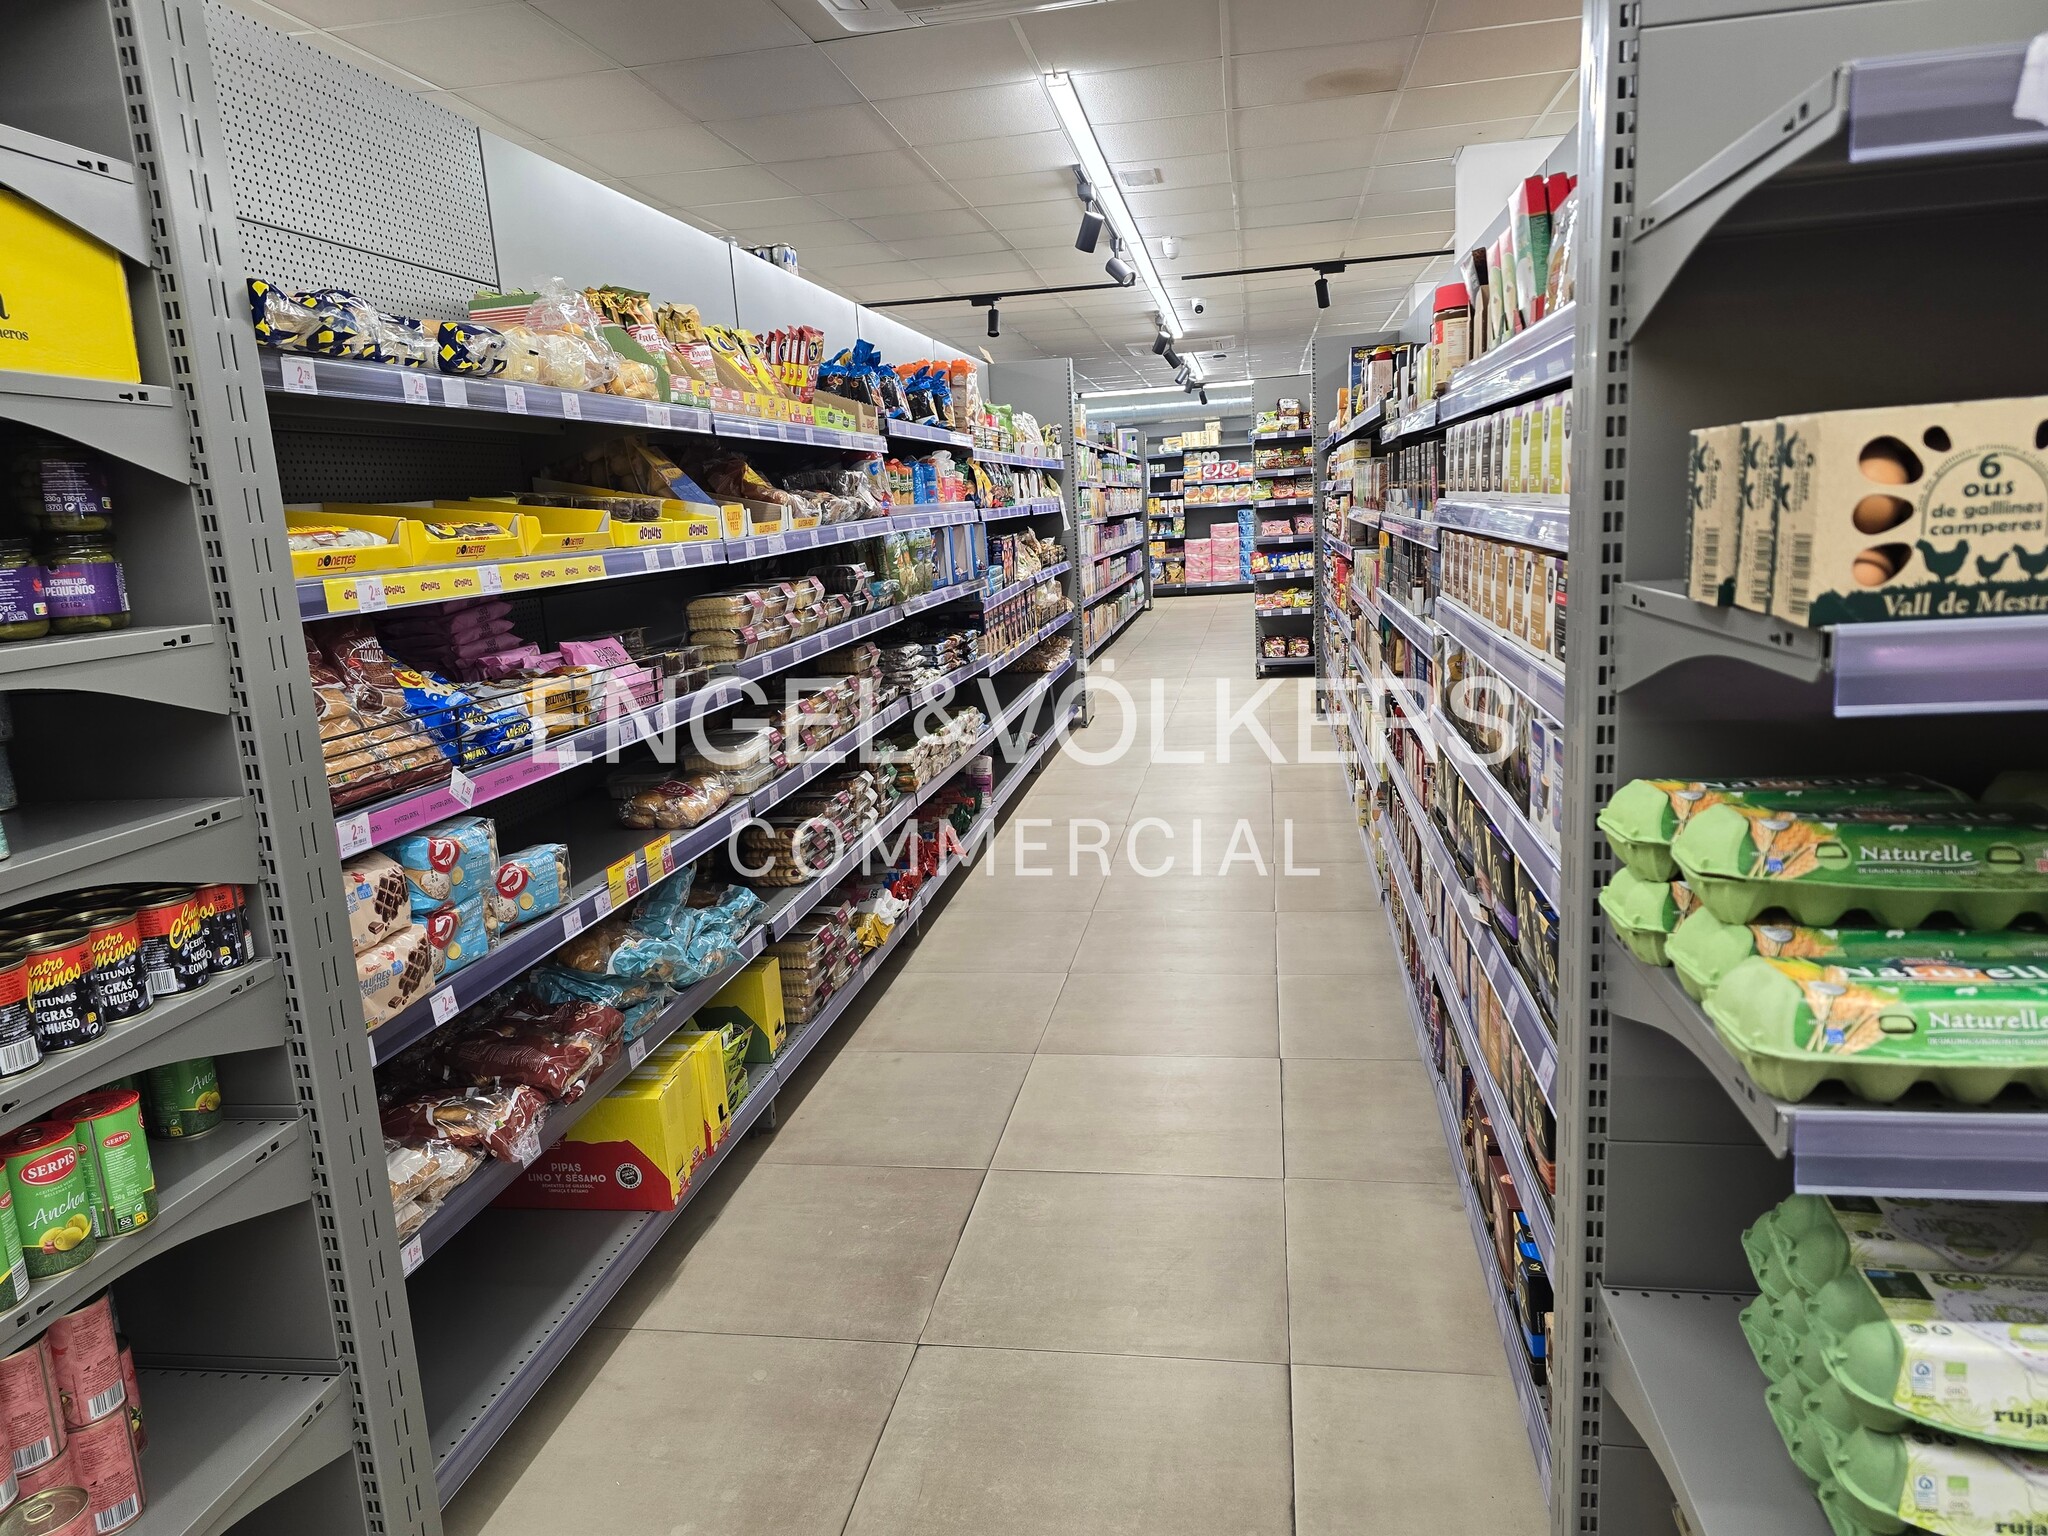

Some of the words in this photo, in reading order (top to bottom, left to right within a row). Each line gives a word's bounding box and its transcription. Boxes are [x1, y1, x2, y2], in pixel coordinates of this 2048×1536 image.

[1979, 452, 2001, 479] 6
[1964, 481, 2014, 497] ous
[1931, 504, 1956, 518] de
[640, 525, 662, 540] donuts
[689, 524, 708, 536] donuts
[1930, 520, 2042, 536] camperes
[456, 544, 486, 555] DONETTES
[317, 555, 356, 567] DONETTES
[421, 581, 440, 591] donuts
[454, 578, 473, 588] donuts
[1883, 591, 1932, 617] Vall
[1937, 591, 1970, 614] de
[1860, 844, 1974, 862] Naturelle
[95, 936, 137, 968] minos
[97, 964, 135, 981] EITUNAS
[99, 978, 134, 996] EGRAS
[33, 992, 77, 1008] EITUNAS
[110, 989, 139, 1006] HUESO
[36, 1006, 74, 1023] EGRAS
[45, 1018, 80, 1035] HUESO
[105, 1133, 129, 1146] SERPIS
[27, 1152, 75, 1179] SERPIS
[551, 1163, 581, 1172] PIPAS
[528, 1173, 552, 1182] LINO
[555, 1174, 561, 1182] Y
[565, 1172, 607, 1183] SÉSAMO
[27, 1191, 85, 1230] Anchoa
